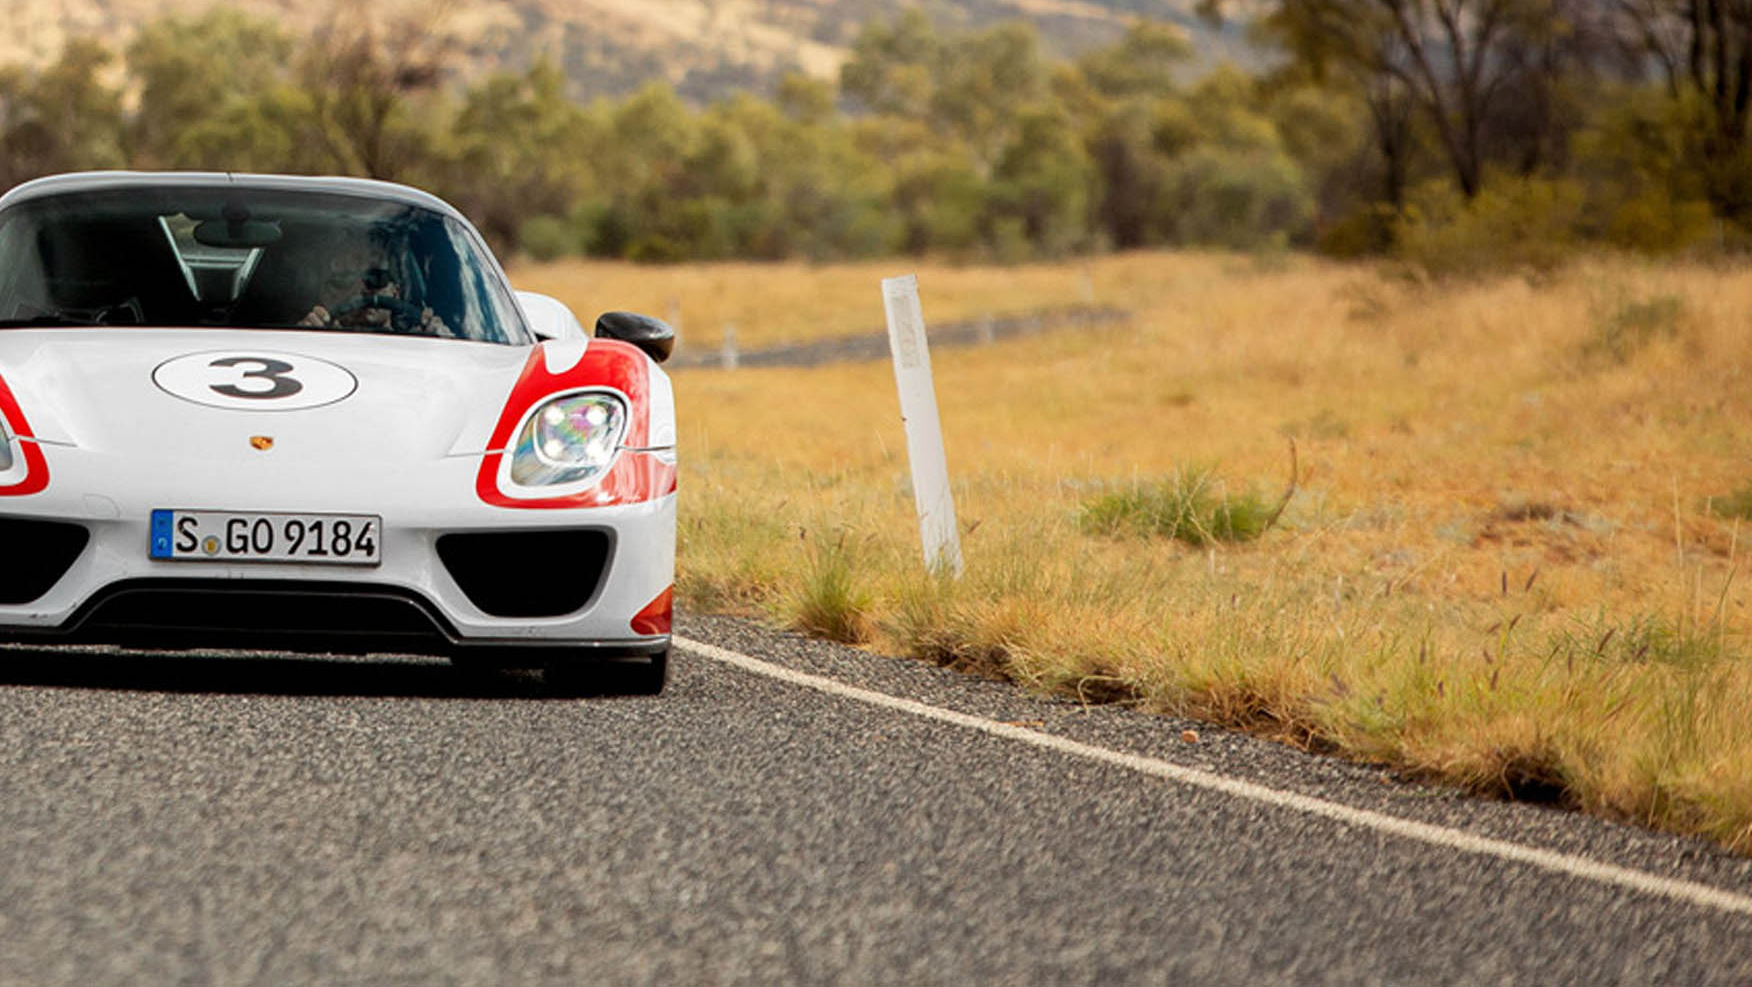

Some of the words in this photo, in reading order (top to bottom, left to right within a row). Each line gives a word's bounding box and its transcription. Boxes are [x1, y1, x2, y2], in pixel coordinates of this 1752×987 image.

[209, 357, 303, 399] 3
[176, 517, 199, 553] S
[225, 518, 274, 554] GO
[284, 520, 375, 557] 9184
